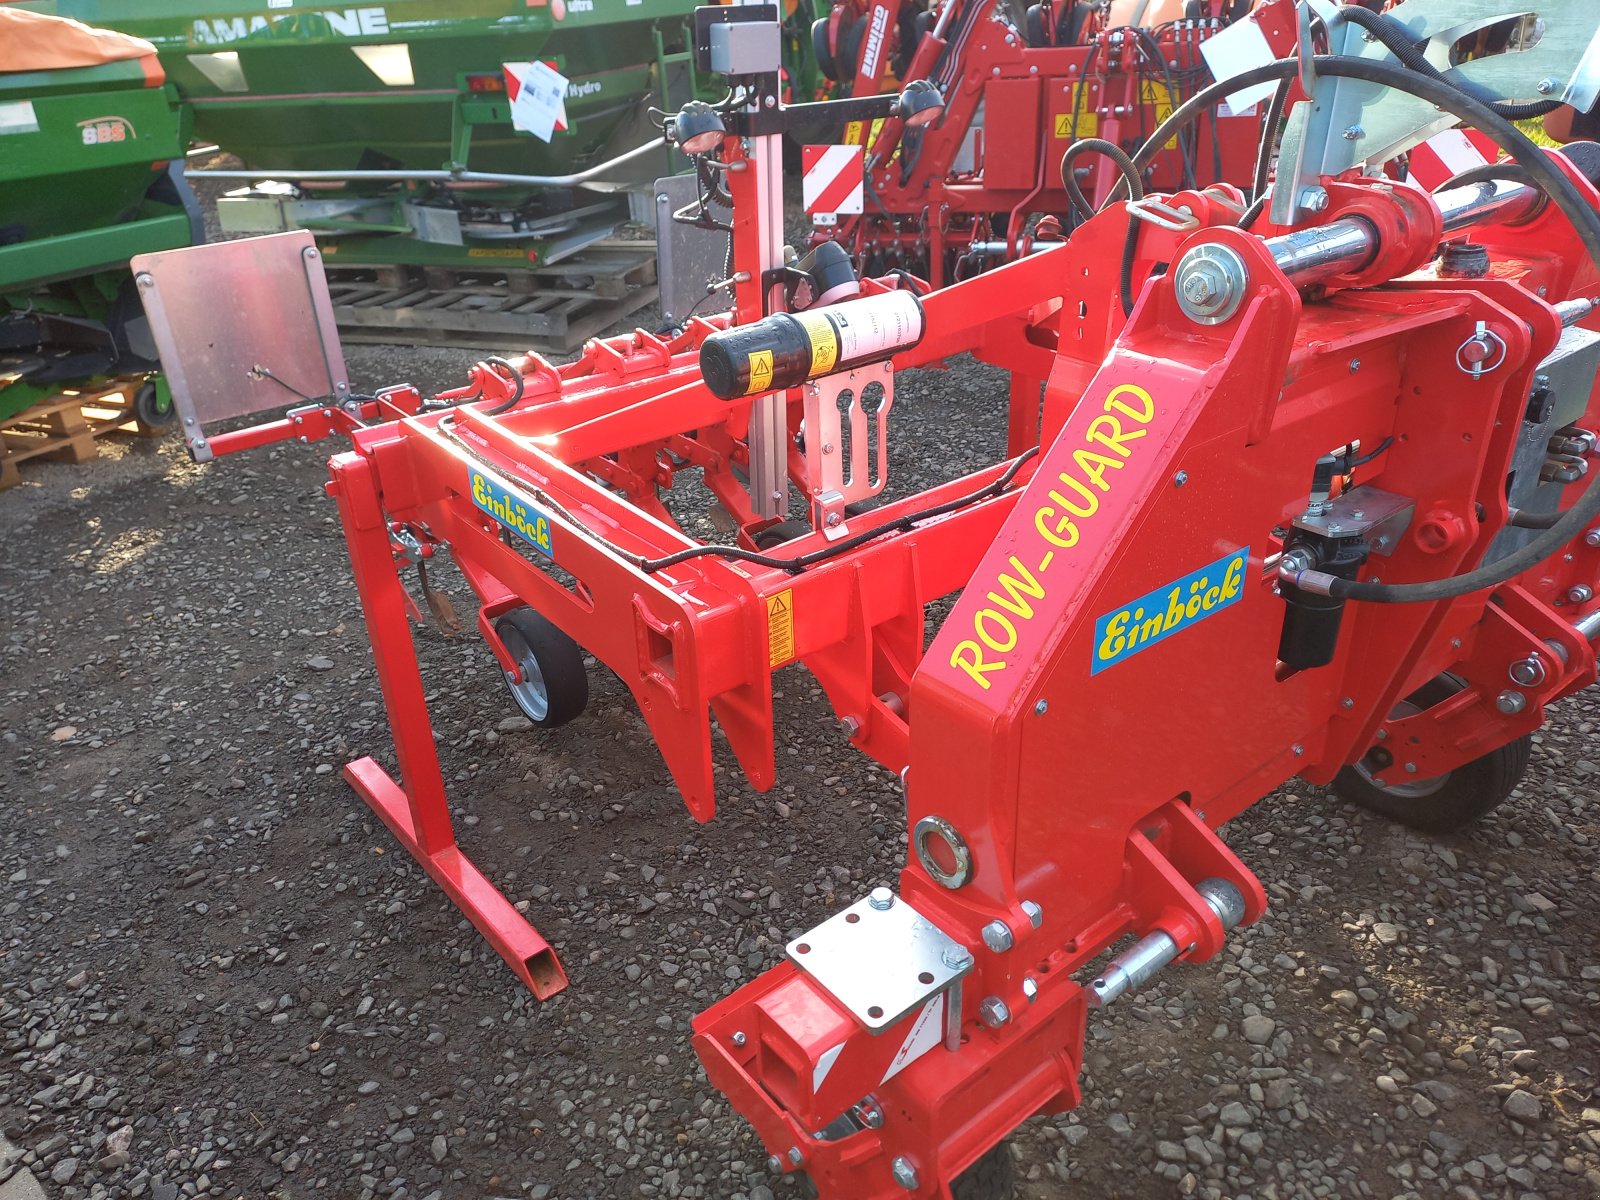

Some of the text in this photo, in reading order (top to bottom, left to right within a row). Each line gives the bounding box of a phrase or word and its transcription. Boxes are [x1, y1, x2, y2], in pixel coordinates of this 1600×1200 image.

[567, 0, 593, 12] ultra
[860, 4, 886, 77] GRIMME
[568, 81, 602, 97] Hydro
[473, 473, 550, 550] Einböck
[950, 384, 1155, 690] ROW-GUARD
[1098, 556, 1244, 661] Einböck
